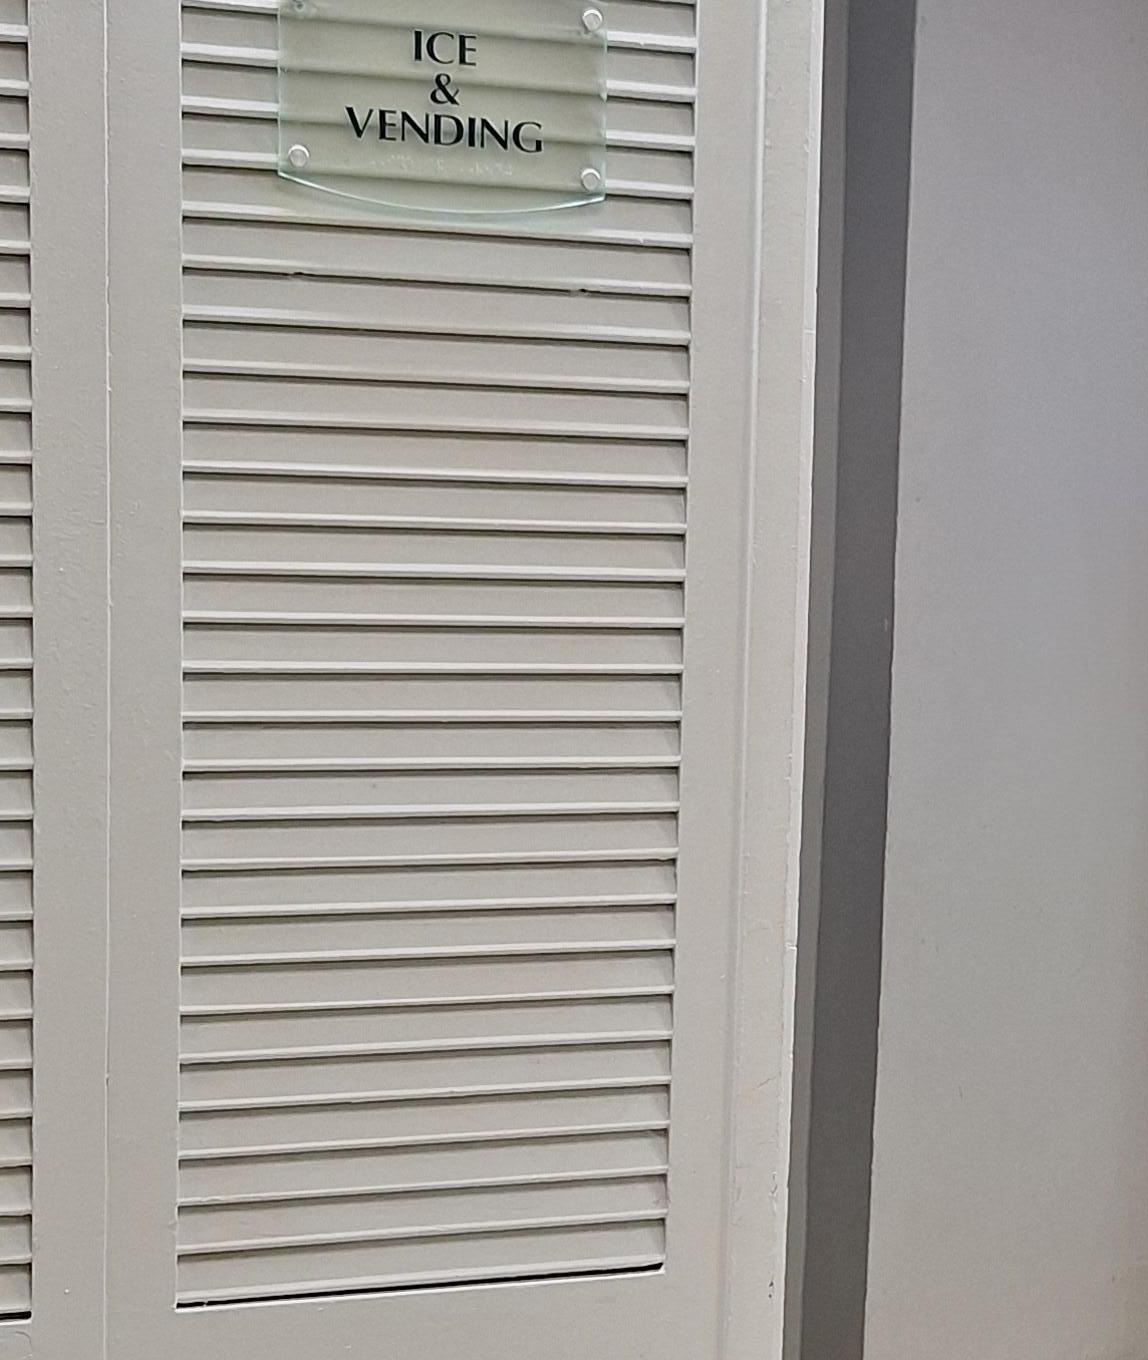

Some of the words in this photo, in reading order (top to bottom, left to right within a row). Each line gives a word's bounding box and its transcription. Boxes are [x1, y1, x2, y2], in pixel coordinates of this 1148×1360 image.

[412, 30, 477, 67] ICE
[429, 72, 461, 106] &
[344, 105, 544, 154] VENDING
